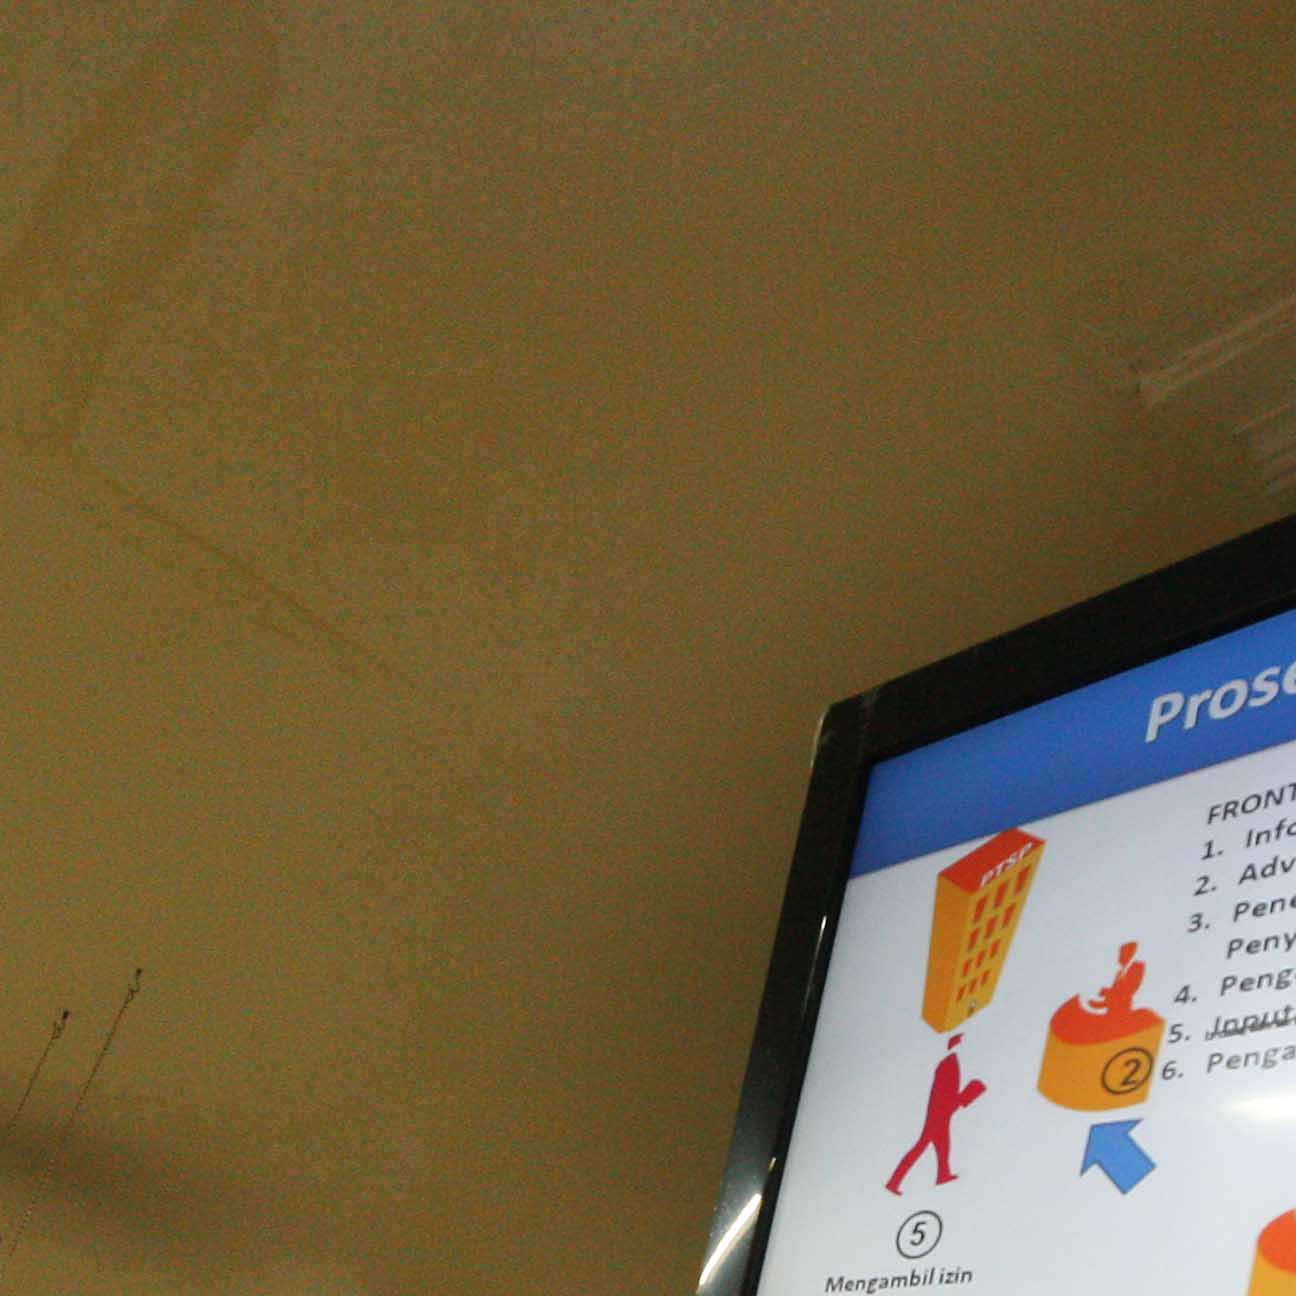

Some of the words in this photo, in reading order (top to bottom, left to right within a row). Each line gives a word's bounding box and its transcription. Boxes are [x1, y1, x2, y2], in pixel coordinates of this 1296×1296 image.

[1201, 840, 1223, 861] 1.
[1193, 876, 1217, 897] 2.
[1187, 913, 1211, 934] 3.
[1174, 984, 1198, 1005] 4.
[1168, 1023, 1191, 1045] 5.
[1120, 1059, 1142, 1088] 2
[1161, 1060, 1185, 1081] 6.
[910, 1222, 926, 1247] 5
[825, 1268, 934, 1295] Mengambil
[938, 1266, 974, 1287] izin
